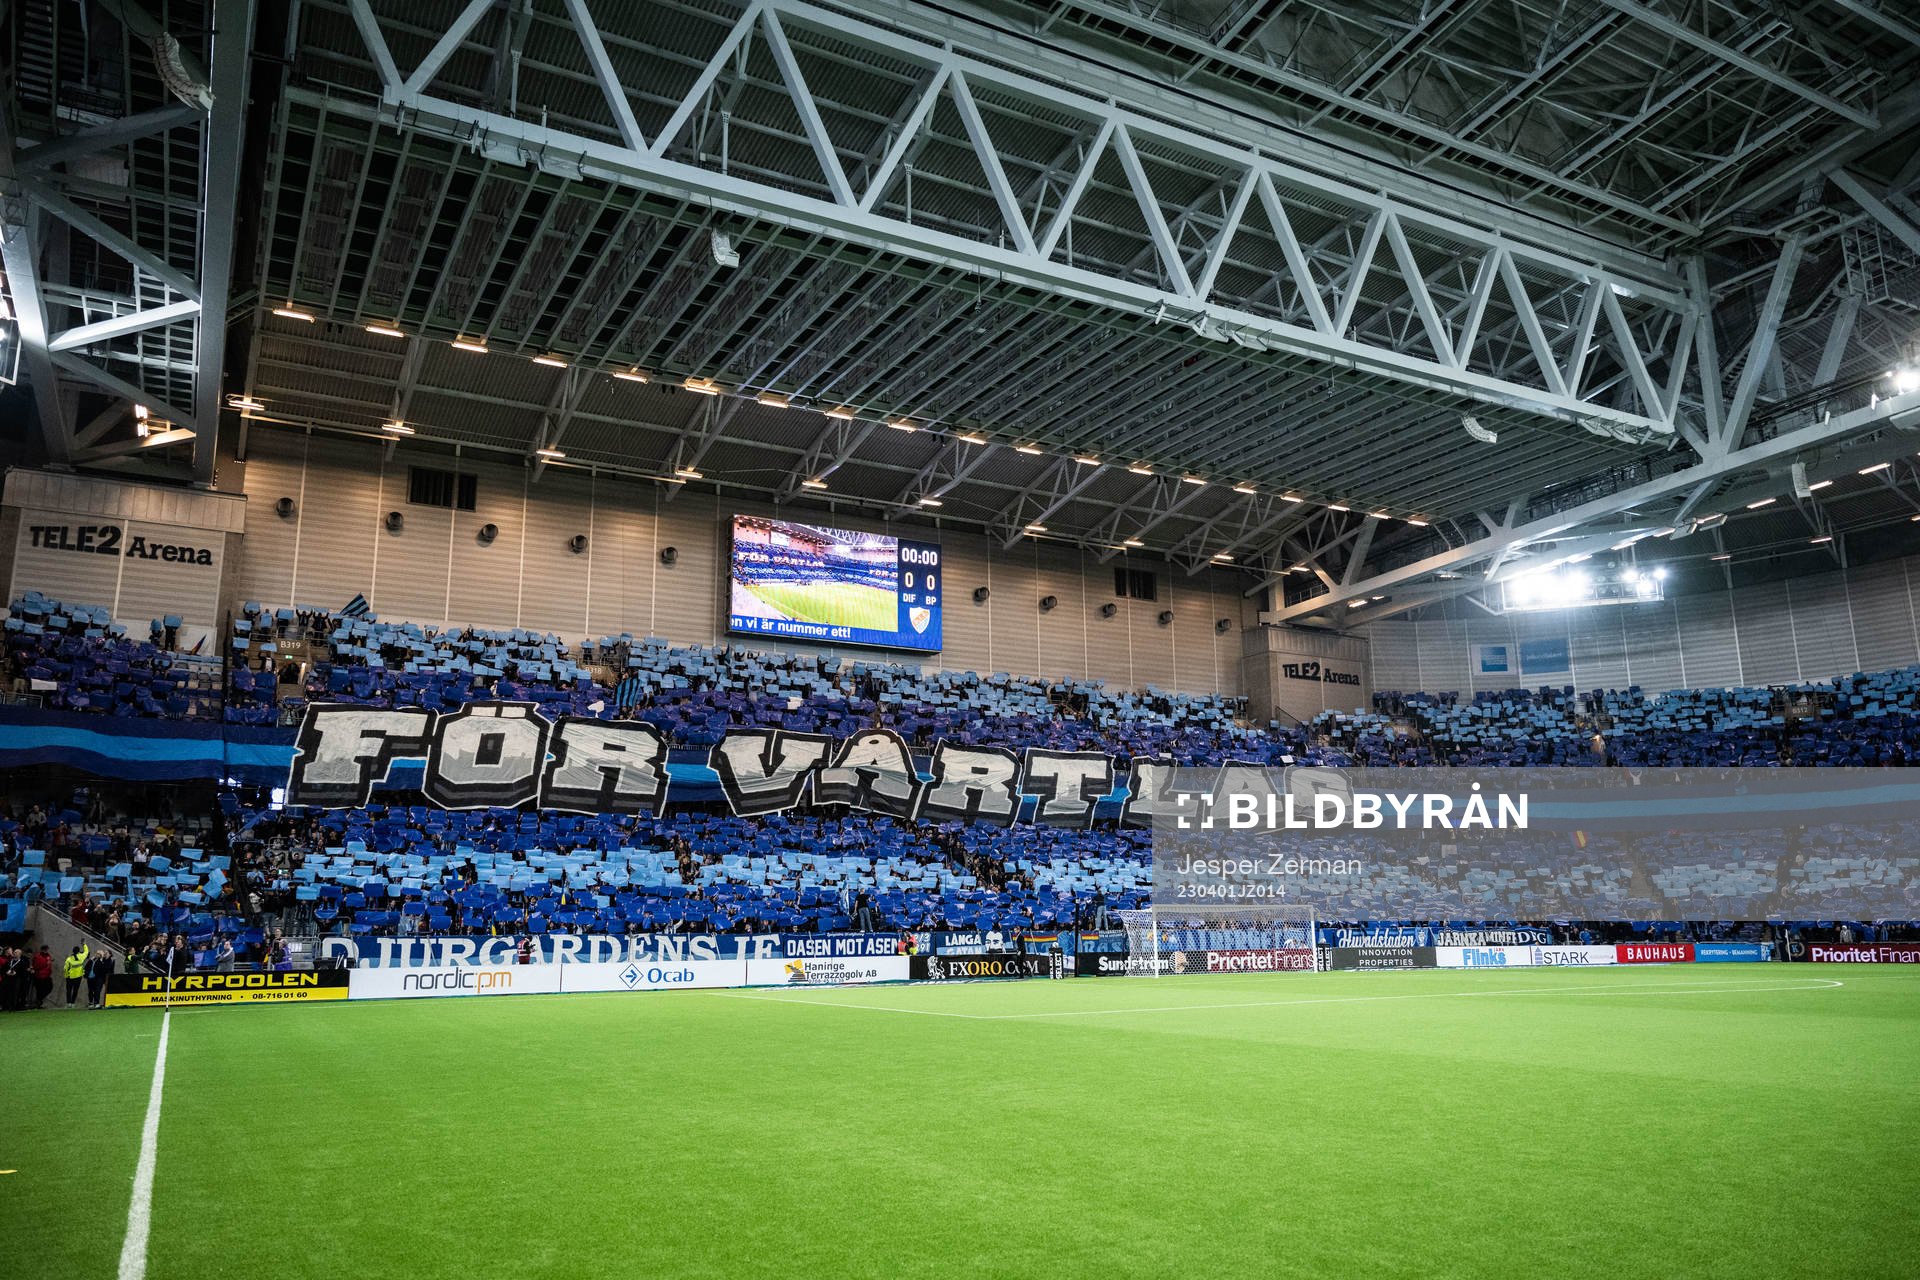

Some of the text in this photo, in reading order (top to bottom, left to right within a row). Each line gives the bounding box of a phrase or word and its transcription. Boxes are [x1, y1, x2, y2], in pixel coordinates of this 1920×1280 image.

[30, 525, 213, 566] TELE2 Arena
[902, 547, 938, 566] 00:00
[905, 572, 936, 591] 0 0
[903, 593, 937, 605] DIF BP
[746, 617, 758, 629] vi
[761, 618, 774, 631] är
[777, 622, 828, 636] nummer
[831, 627, 851, 638] ett!
[1282, 661, 1360, 686] TELE2 Arena
[285, 700, 670, 819] FÖR
[836, 938, 865, 956] MOT
[1627, 946, 1685, 960] BAUHAUS
[1811, 947, 1878, 962] Prioritet
[1207, 952, 1274, 971] Prioritet
[1462, 948, 1507, 965] Flinks
[1543, 951, 1589, 964] STARK
[647, 967, 695, 984] Ocab
[804, 962, 845, 973] Haninge
[805, 969, 877, 980] Terrazzogolv AB
[142, 973, 318, 990] HYRPOOLEN
[151, 993, 232, 1003] MASKINUTHYRNING
[252, 992, 282, 1000] 08-716
[297, 991, 308, 999] 60
